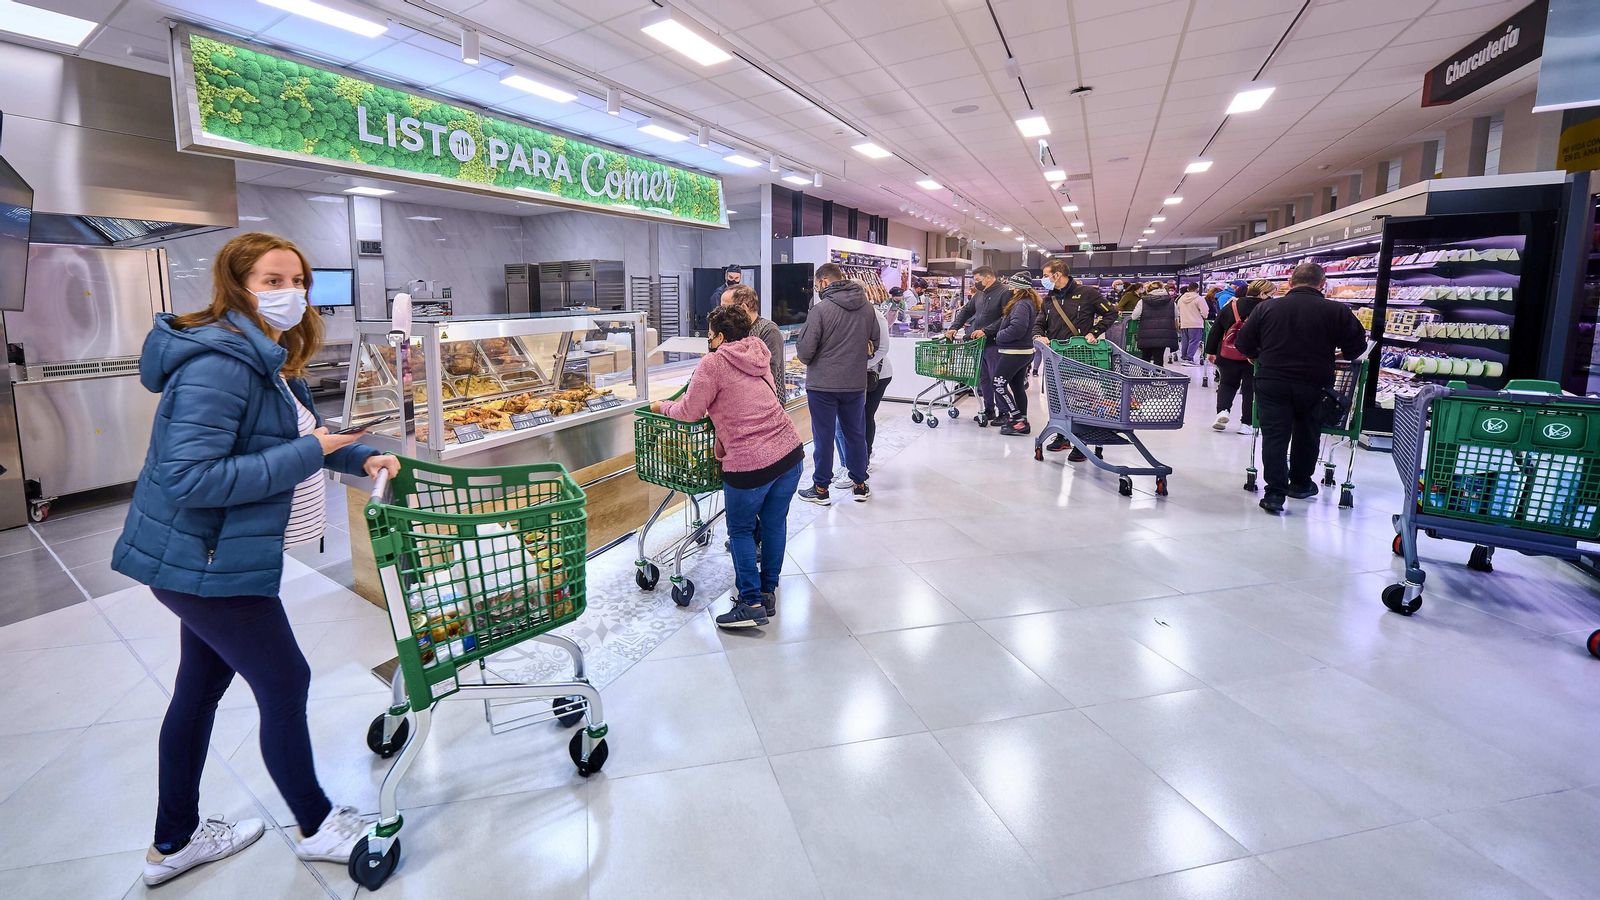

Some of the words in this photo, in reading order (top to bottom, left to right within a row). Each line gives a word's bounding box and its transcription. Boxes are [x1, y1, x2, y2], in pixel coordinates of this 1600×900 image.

[1445, 24, 1521, 86] Charcutería
[358, 105, 476, 162] LISTO
[489, 137, 573, 184] PARA
[580, 152, 678, 204] Comer
